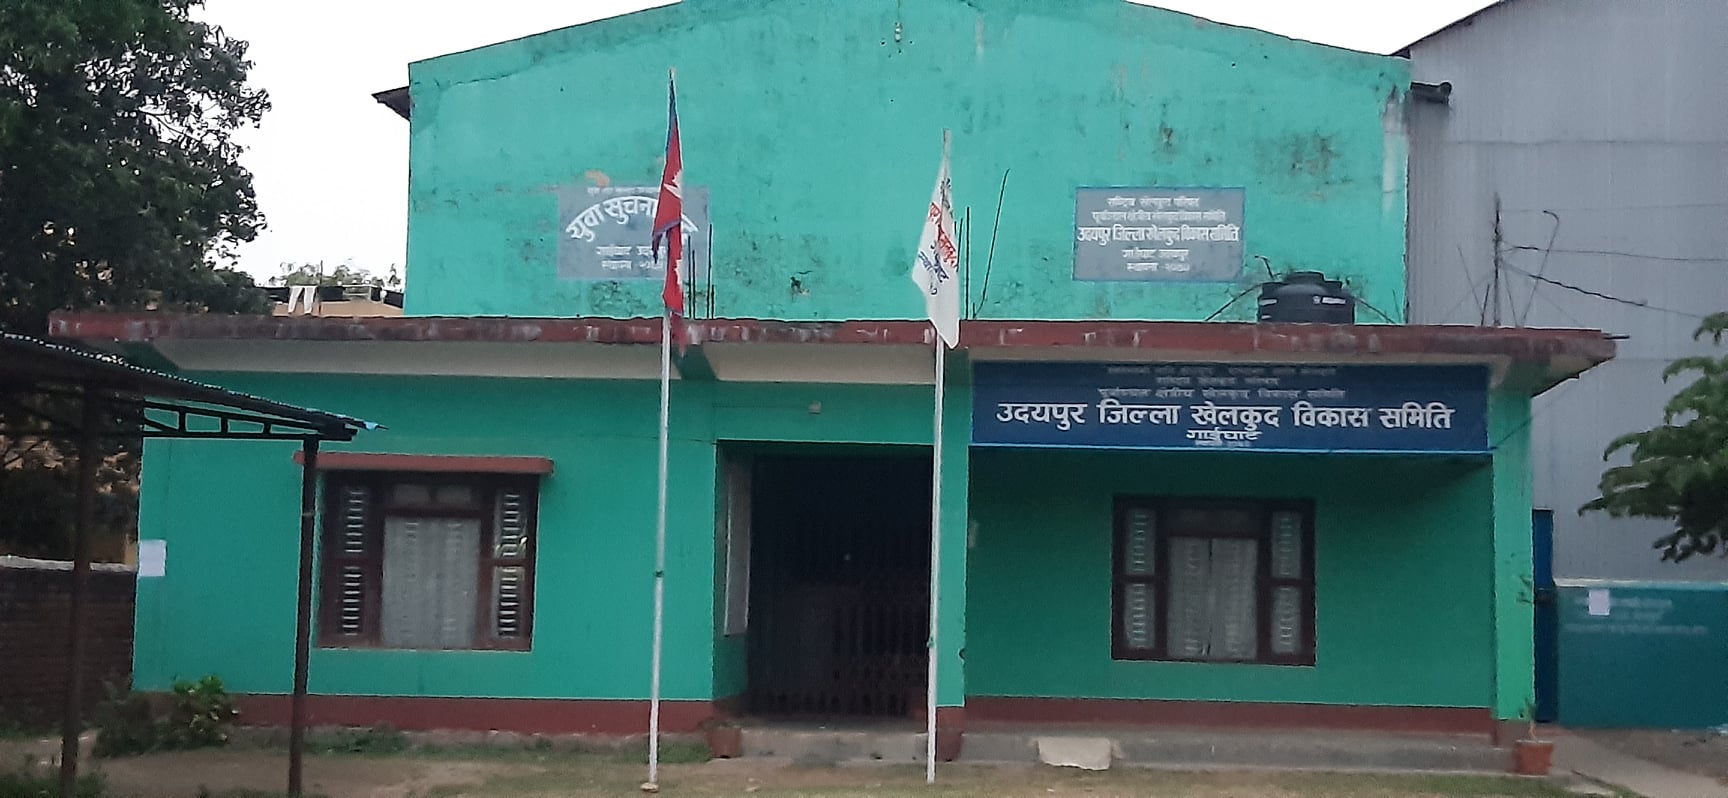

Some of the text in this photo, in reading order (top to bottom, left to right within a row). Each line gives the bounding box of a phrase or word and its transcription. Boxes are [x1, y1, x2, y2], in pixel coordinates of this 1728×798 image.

[566, 203, 605, 242] युवा
[1077, 226, 1111, 246] उदयपुर
[1112, 224, 1146, 241] जिल्ला
[996, 398, 1455, 432] उदयपुर जिल्ला खेलकुद विकास समिति
